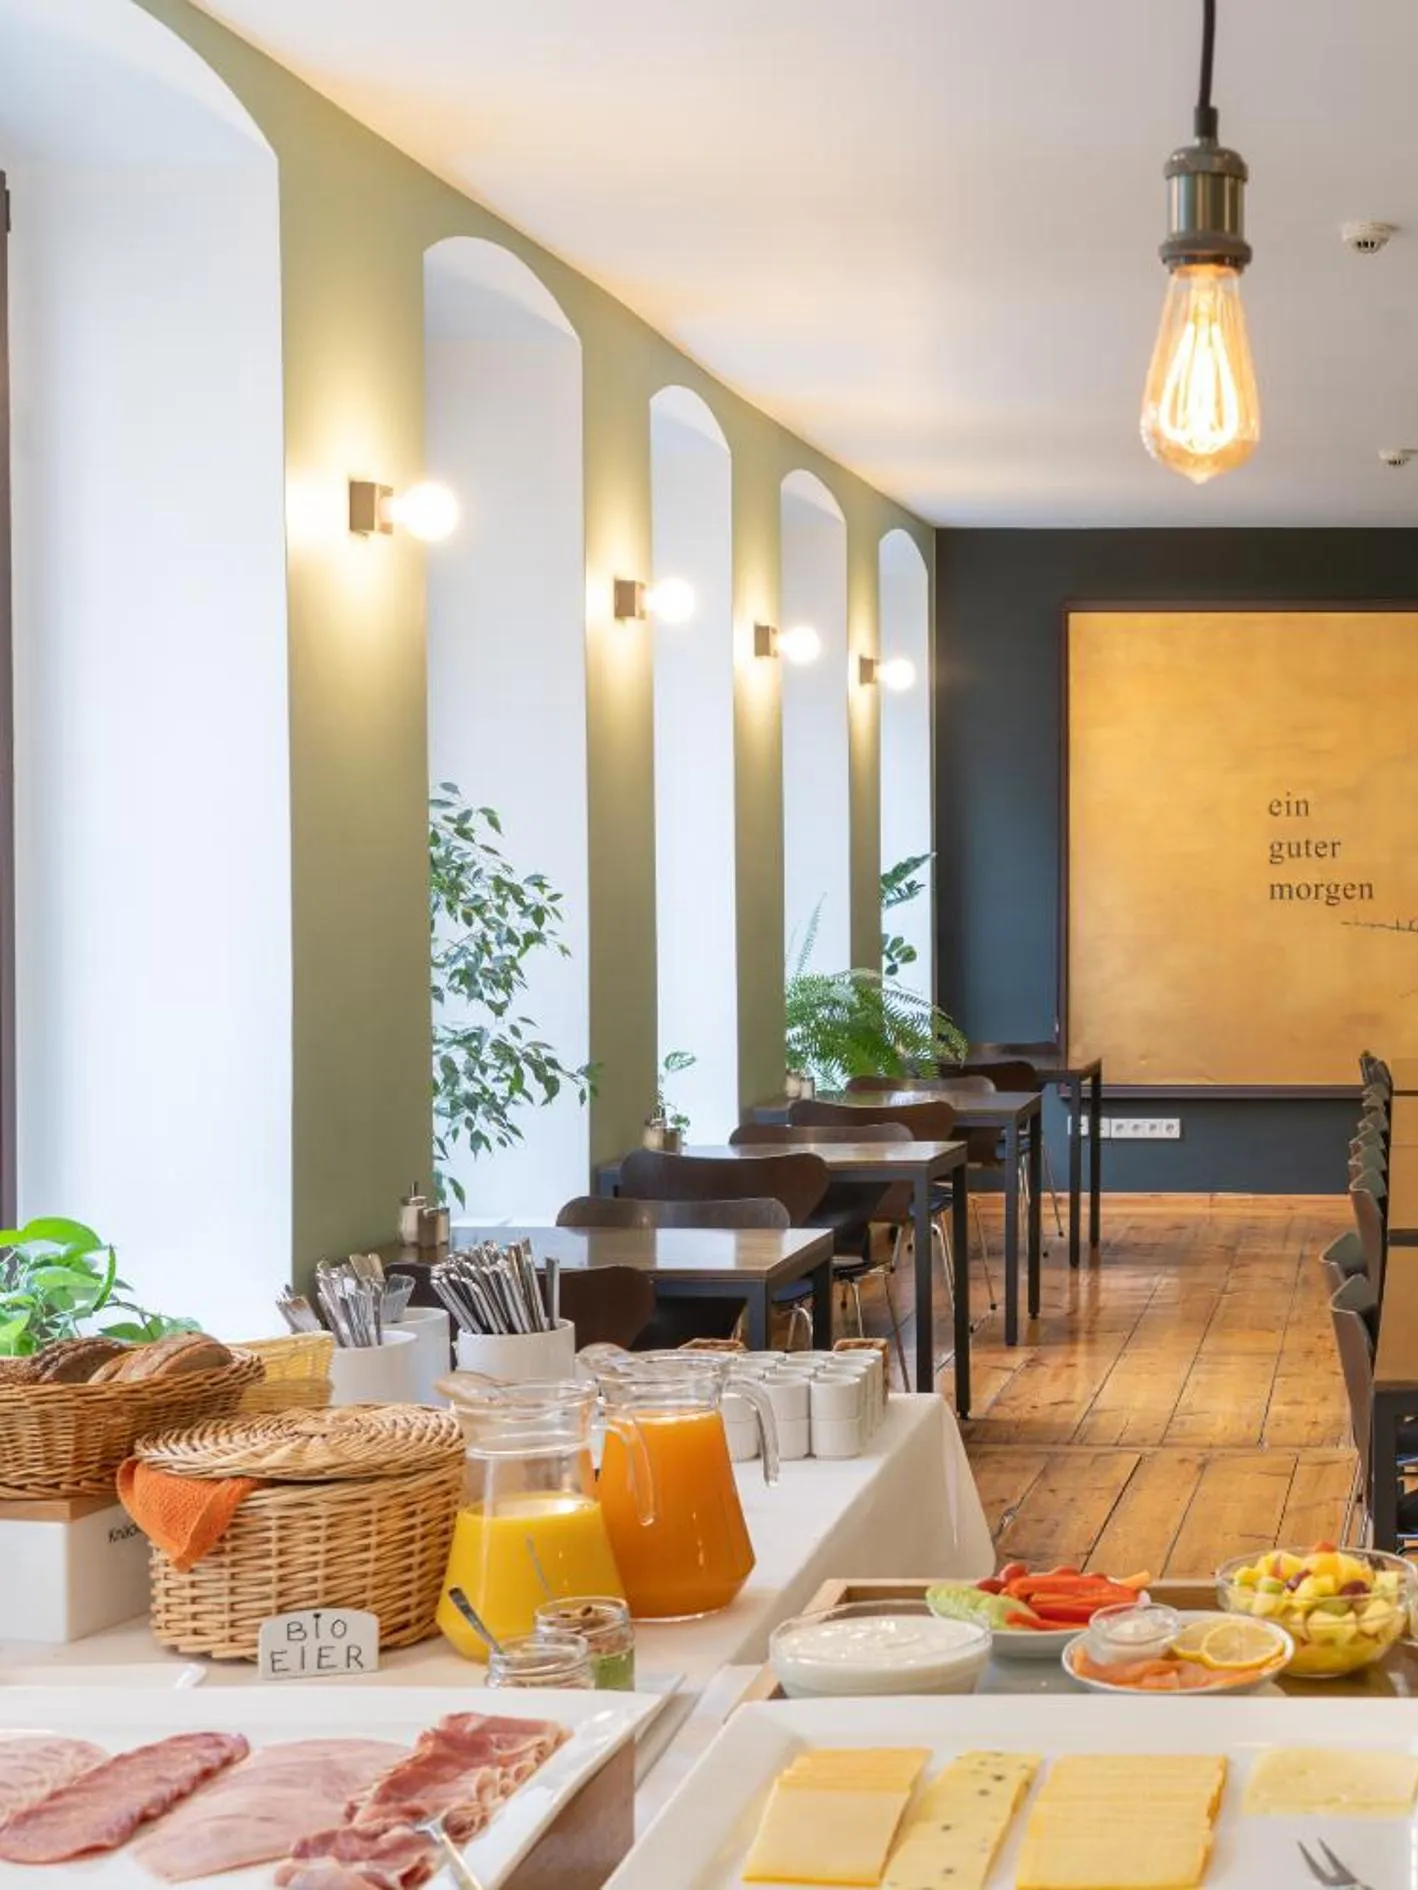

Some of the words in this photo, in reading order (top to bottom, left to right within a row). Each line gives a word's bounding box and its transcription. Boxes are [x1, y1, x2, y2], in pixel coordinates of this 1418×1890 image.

[1268, 791, 1309, 817] ein
[1268, 838, 1341, 865] guter
[1269, 881, 1373, 906] morgen
[270, 1644, 364, 1673] EIER
